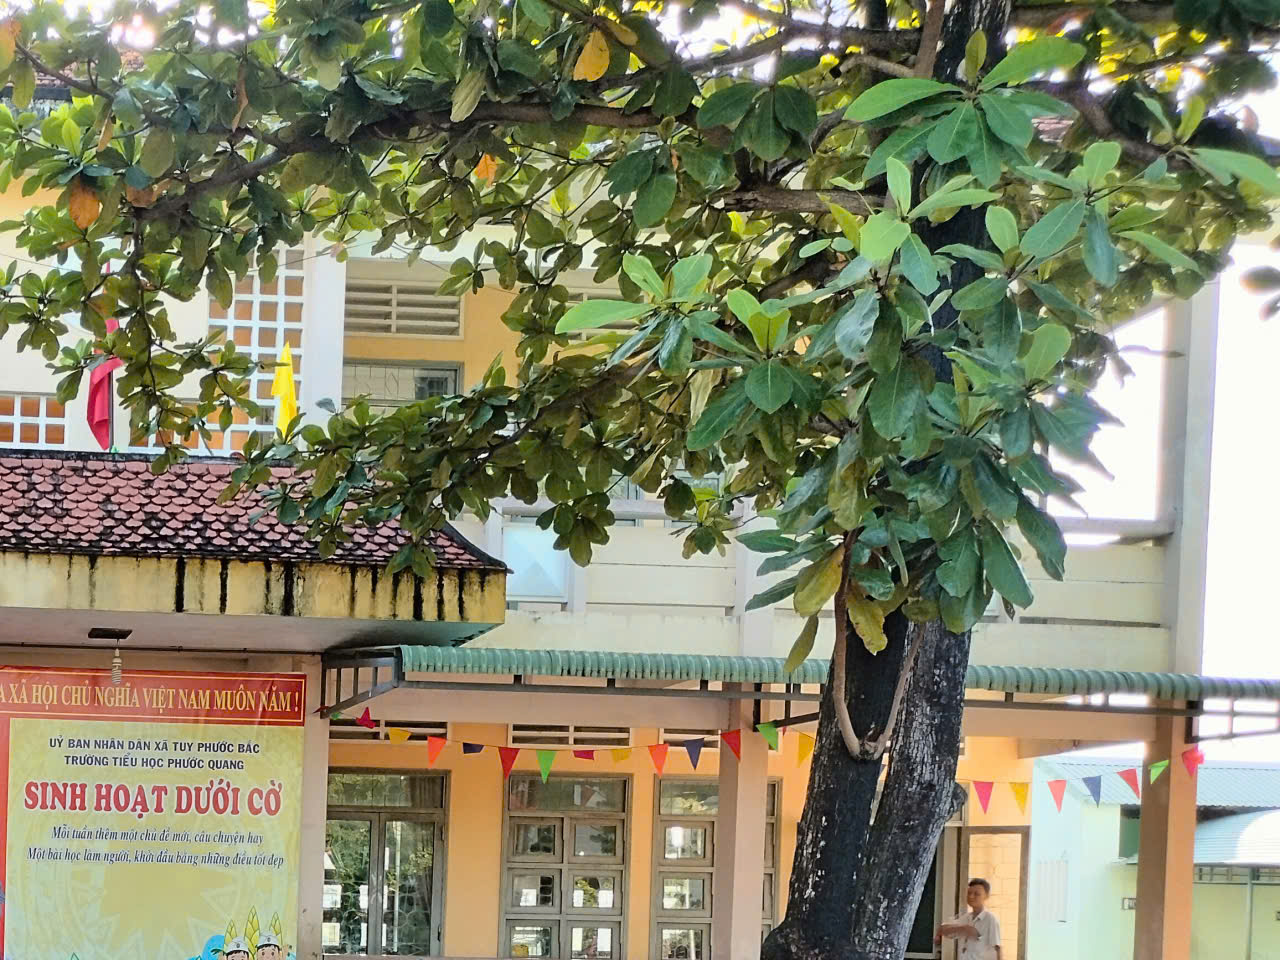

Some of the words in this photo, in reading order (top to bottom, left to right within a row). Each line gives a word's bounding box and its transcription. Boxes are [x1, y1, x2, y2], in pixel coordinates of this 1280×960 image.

[8, 679, 28, 704] XÃ
[31, 681, 58, 710] HỘI
[61, 680, 91, 706] CHỦ
[94, 683, 140, 708] NGHĨA
[142, 685, 176, 714] VIỆT
[178, 687, 210, 710] NAM
[213, 684, 257, 711] MUÔN
[259, 686, 291, 712] NĂM
[49, 735, 64, 748] UỶ
[68, 738, 90, 749] BAN
[94, 737, 124, 750] NHÂN
[128, 738, 151, 751] DÂN
[154, 739, 168, 752] XÃ
[173, 741, 193, 752] TUY
[197, 740, 234, 753] PHƯỚC
[64, 753, 109, 766] TRƯỜNG
[112, 752, 137, 767] TIỂU
[141, 757, 164, 769] HỌC
[168, 757, 204, 769] PHƯỚC
[208, 759, 244, 770] QUANG
[24, 781, 87, 811] SINH
[94, 783, 167, 819] HOẠT
[175, 778, 240, 815] DƯỚI
[247, 779, 282, 816] CỜ
[52, 824, 70, 839] Mỗi
[72, 825, 93, 840] tuần
[95, 827, 118, 840] thêm
[120, 828, 138, 842] một
[140, 828, 157, 841] chủ
[159, 827, 170, 842] đề
[172, 831, 191, 843] mới,
[194, 831, 210, 843] câu
[213, 831, 245, 847] chuyện
[247, 832, 264, 847] hay
[27, 847, 46, 862] Một
[47, 847, 62, 860] bài
[64, 848, 81, 863] học
[83, 848, 101, 861] làm
[103, 849, 131, 864] người,
[134, 849, 154, 863] khởi
[156, 848, 174, 863] đầu
[175, 851, 198, 867] bằng
[201, 852, 230, 867] những
[232, 850, 252, 865] điều
[254, 851, 266, 866] tốt
[268, 853, 284, 869] đẹp
